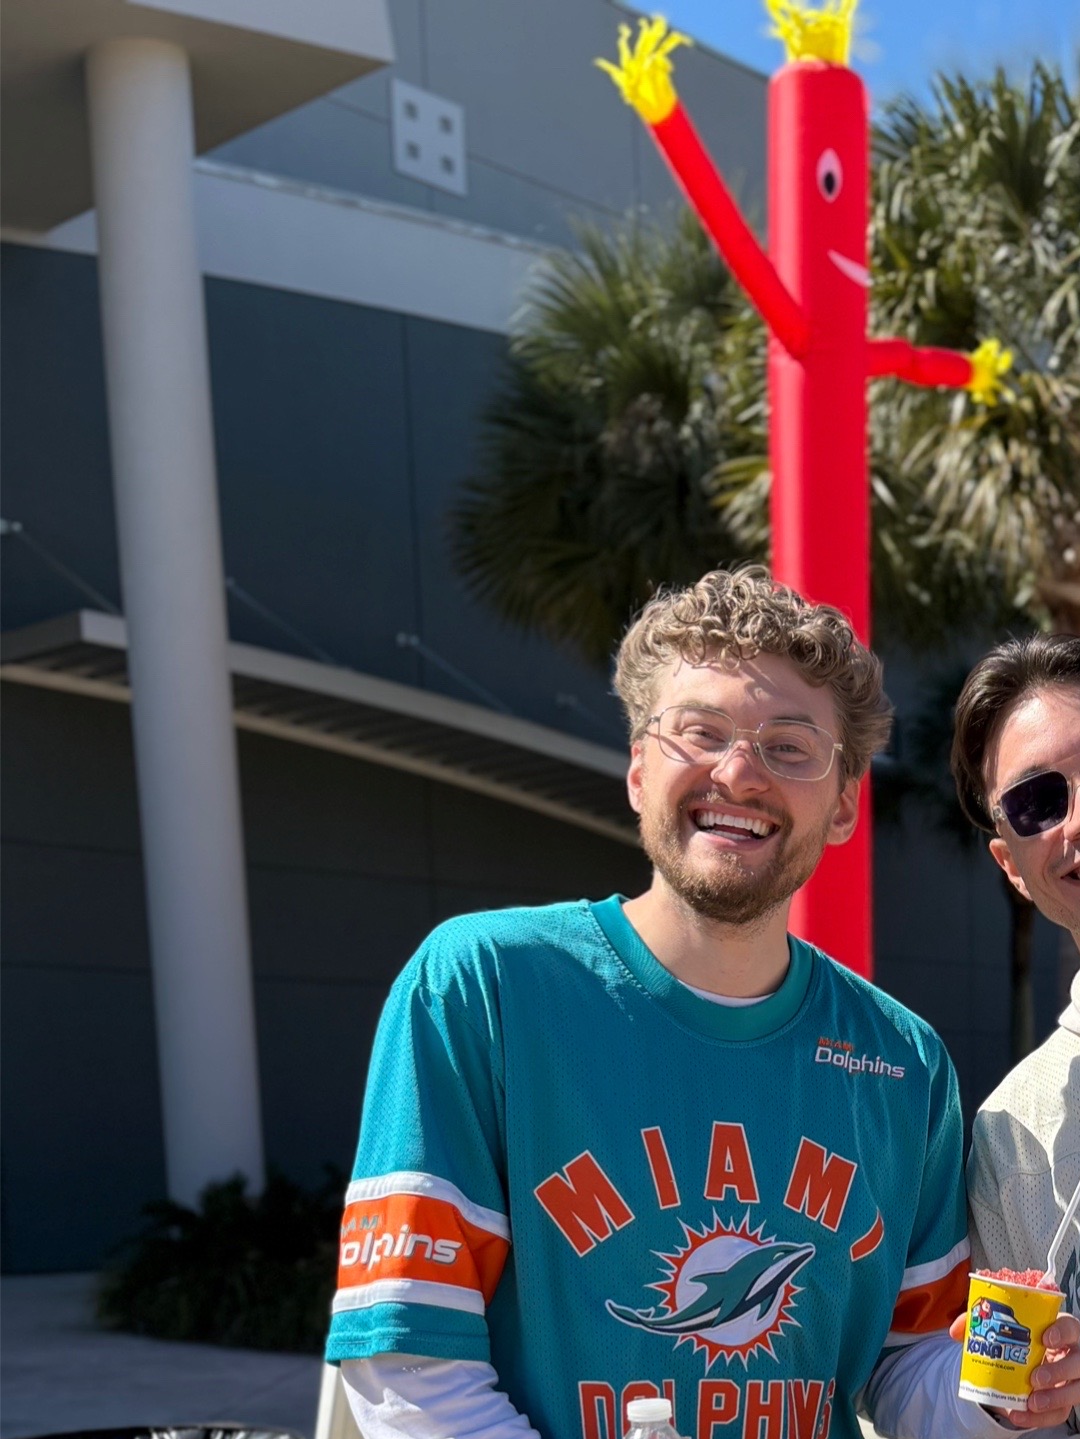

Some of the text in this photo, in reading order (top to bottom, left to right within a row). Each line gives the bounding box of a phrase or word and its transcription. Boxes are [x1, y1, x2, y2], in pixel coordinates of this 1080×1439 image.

[815, 1046, 905, 1078] Dolphins
[340, 1223, 463, 1273] olphins
[966, 1338, 1030, 1365] KONA ICE
